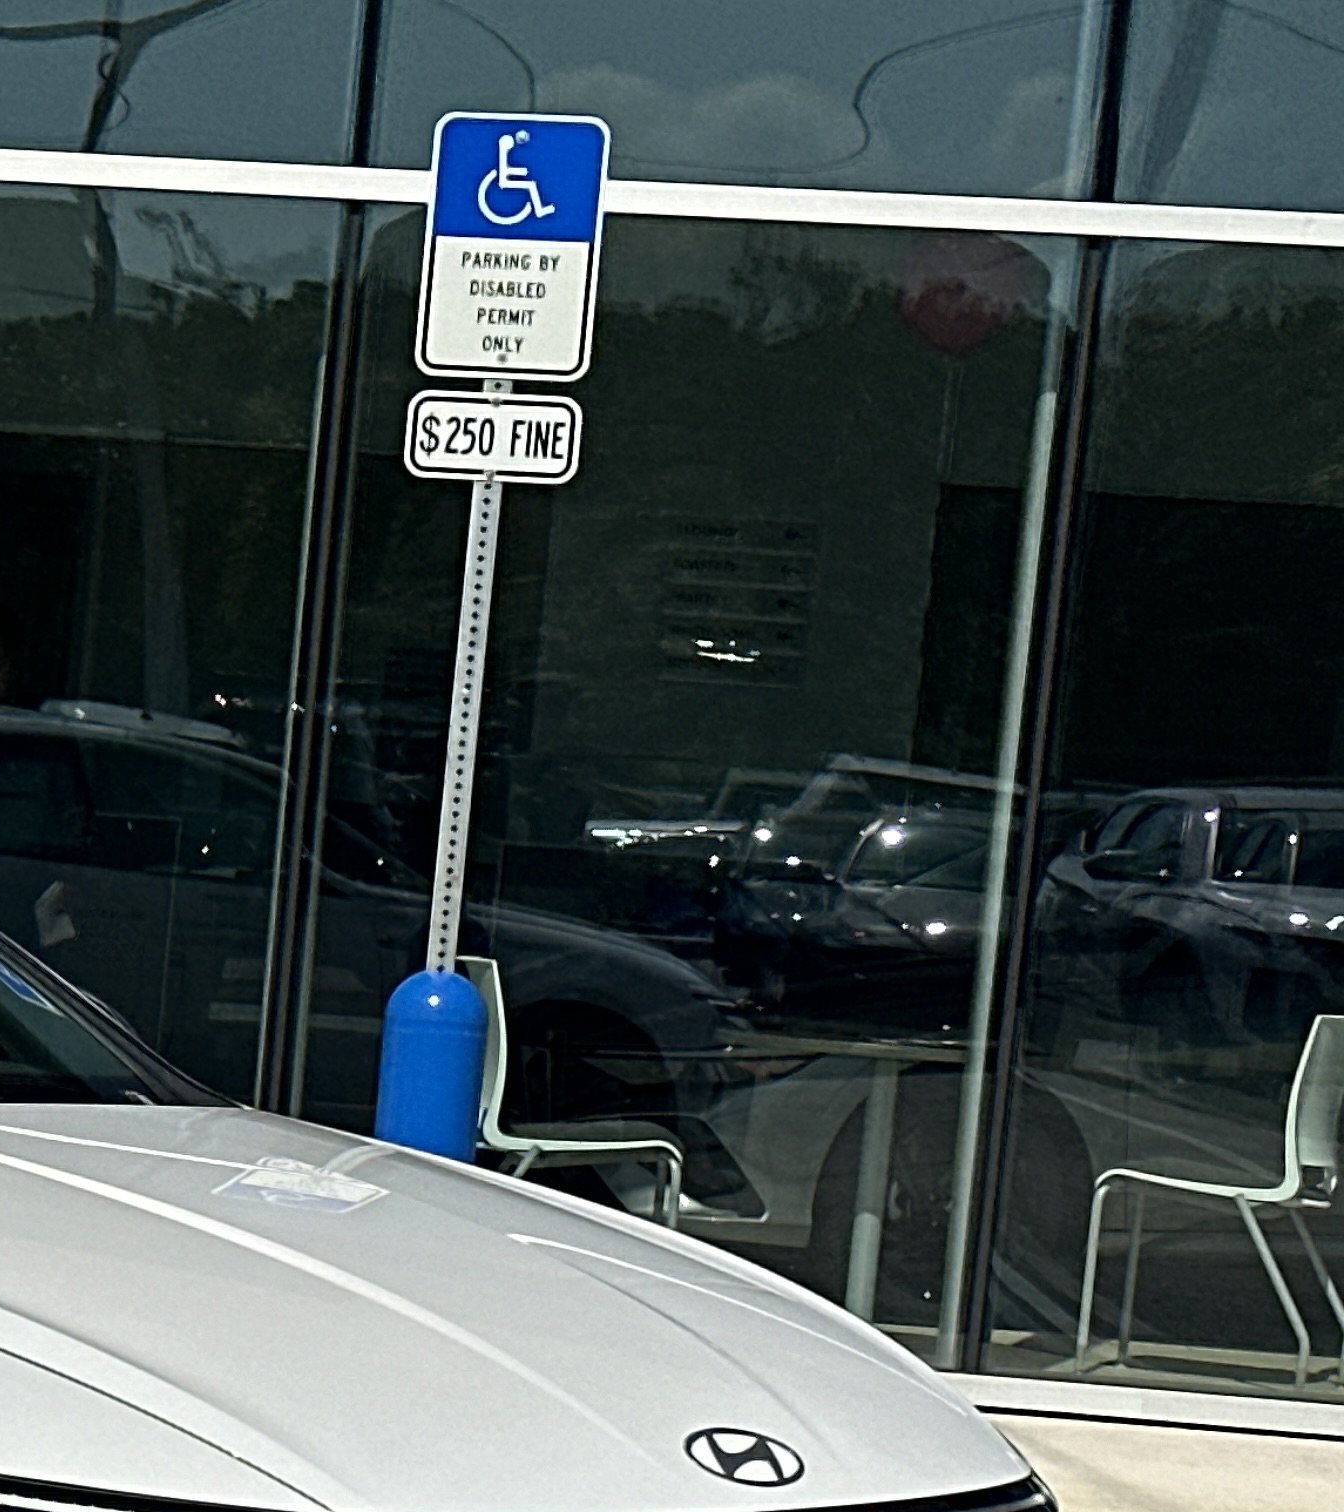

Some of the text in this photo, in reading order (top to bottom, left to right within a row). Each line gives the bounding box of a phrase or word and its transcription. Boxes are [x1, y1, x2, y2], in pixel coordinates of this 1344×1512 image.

[461, 251, 560, 272] PARKING BY
[469, 280, 547, 299] DISABLED
[476, 308, 536, 327] PERMIT
[482, 336, 524, 354] ONLY
[419, 412, 567, 460] $250 FINE
